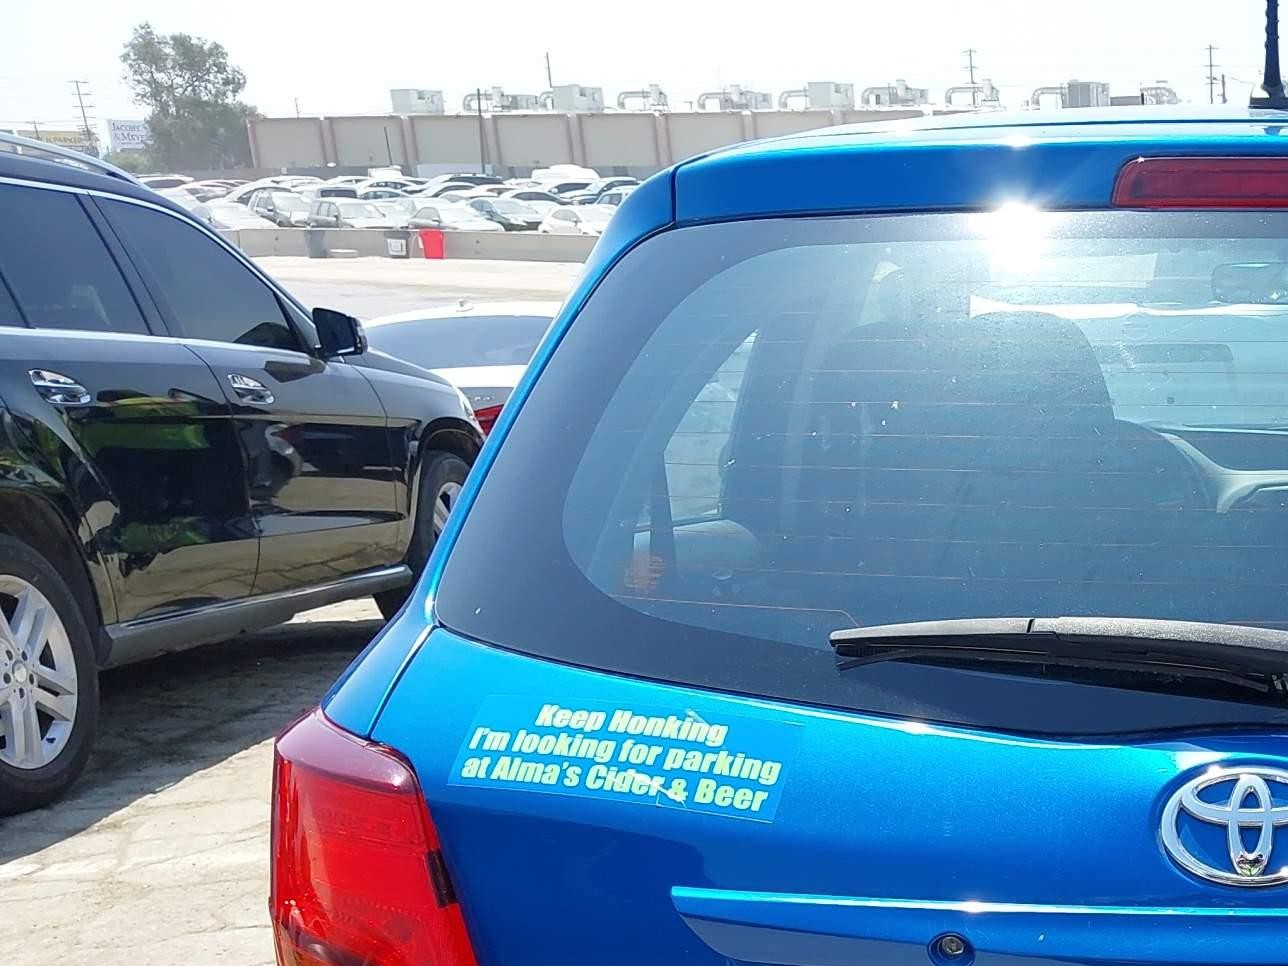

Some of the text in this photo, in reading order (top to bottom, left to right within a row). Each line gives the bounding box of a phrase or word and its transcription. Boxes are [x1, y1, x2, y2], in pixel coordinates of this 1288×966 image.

[535, 704, 729, 747] Keep Honking
[461, 756, 769, 812] at Alma's Cider & Beer
[468, 727, 782, 786] I'm looking for parking
